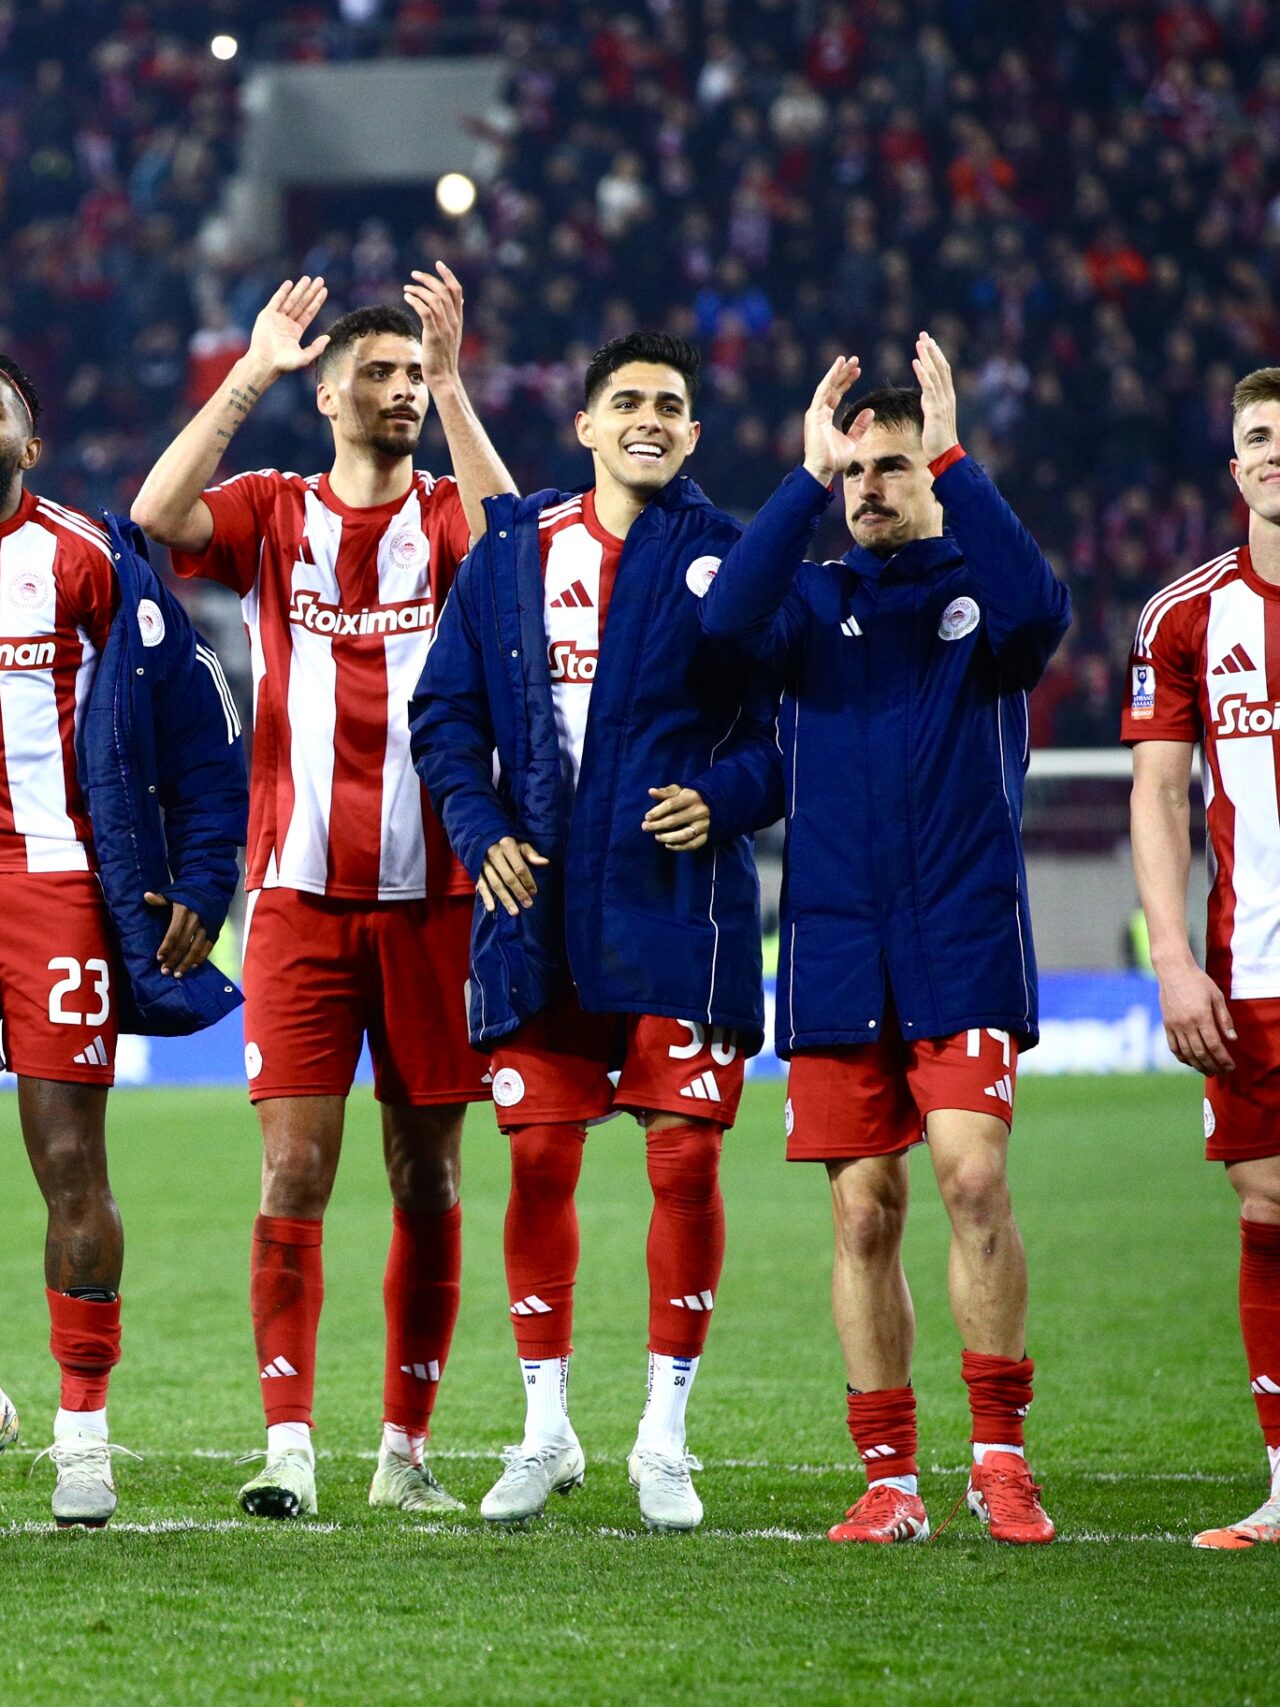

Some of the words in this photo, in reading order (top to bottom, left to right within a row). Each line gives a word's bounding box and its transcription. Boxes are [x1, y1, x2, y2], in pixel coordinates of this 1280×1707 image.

[289, 594, 435, 635] Stoiximan
[550, 646, 598, 680] Sto
[1217, 698, 1280, 735] Stoi
[47, 956, 110, 1027] 23
[674, 1375, 686, 1387] 50
